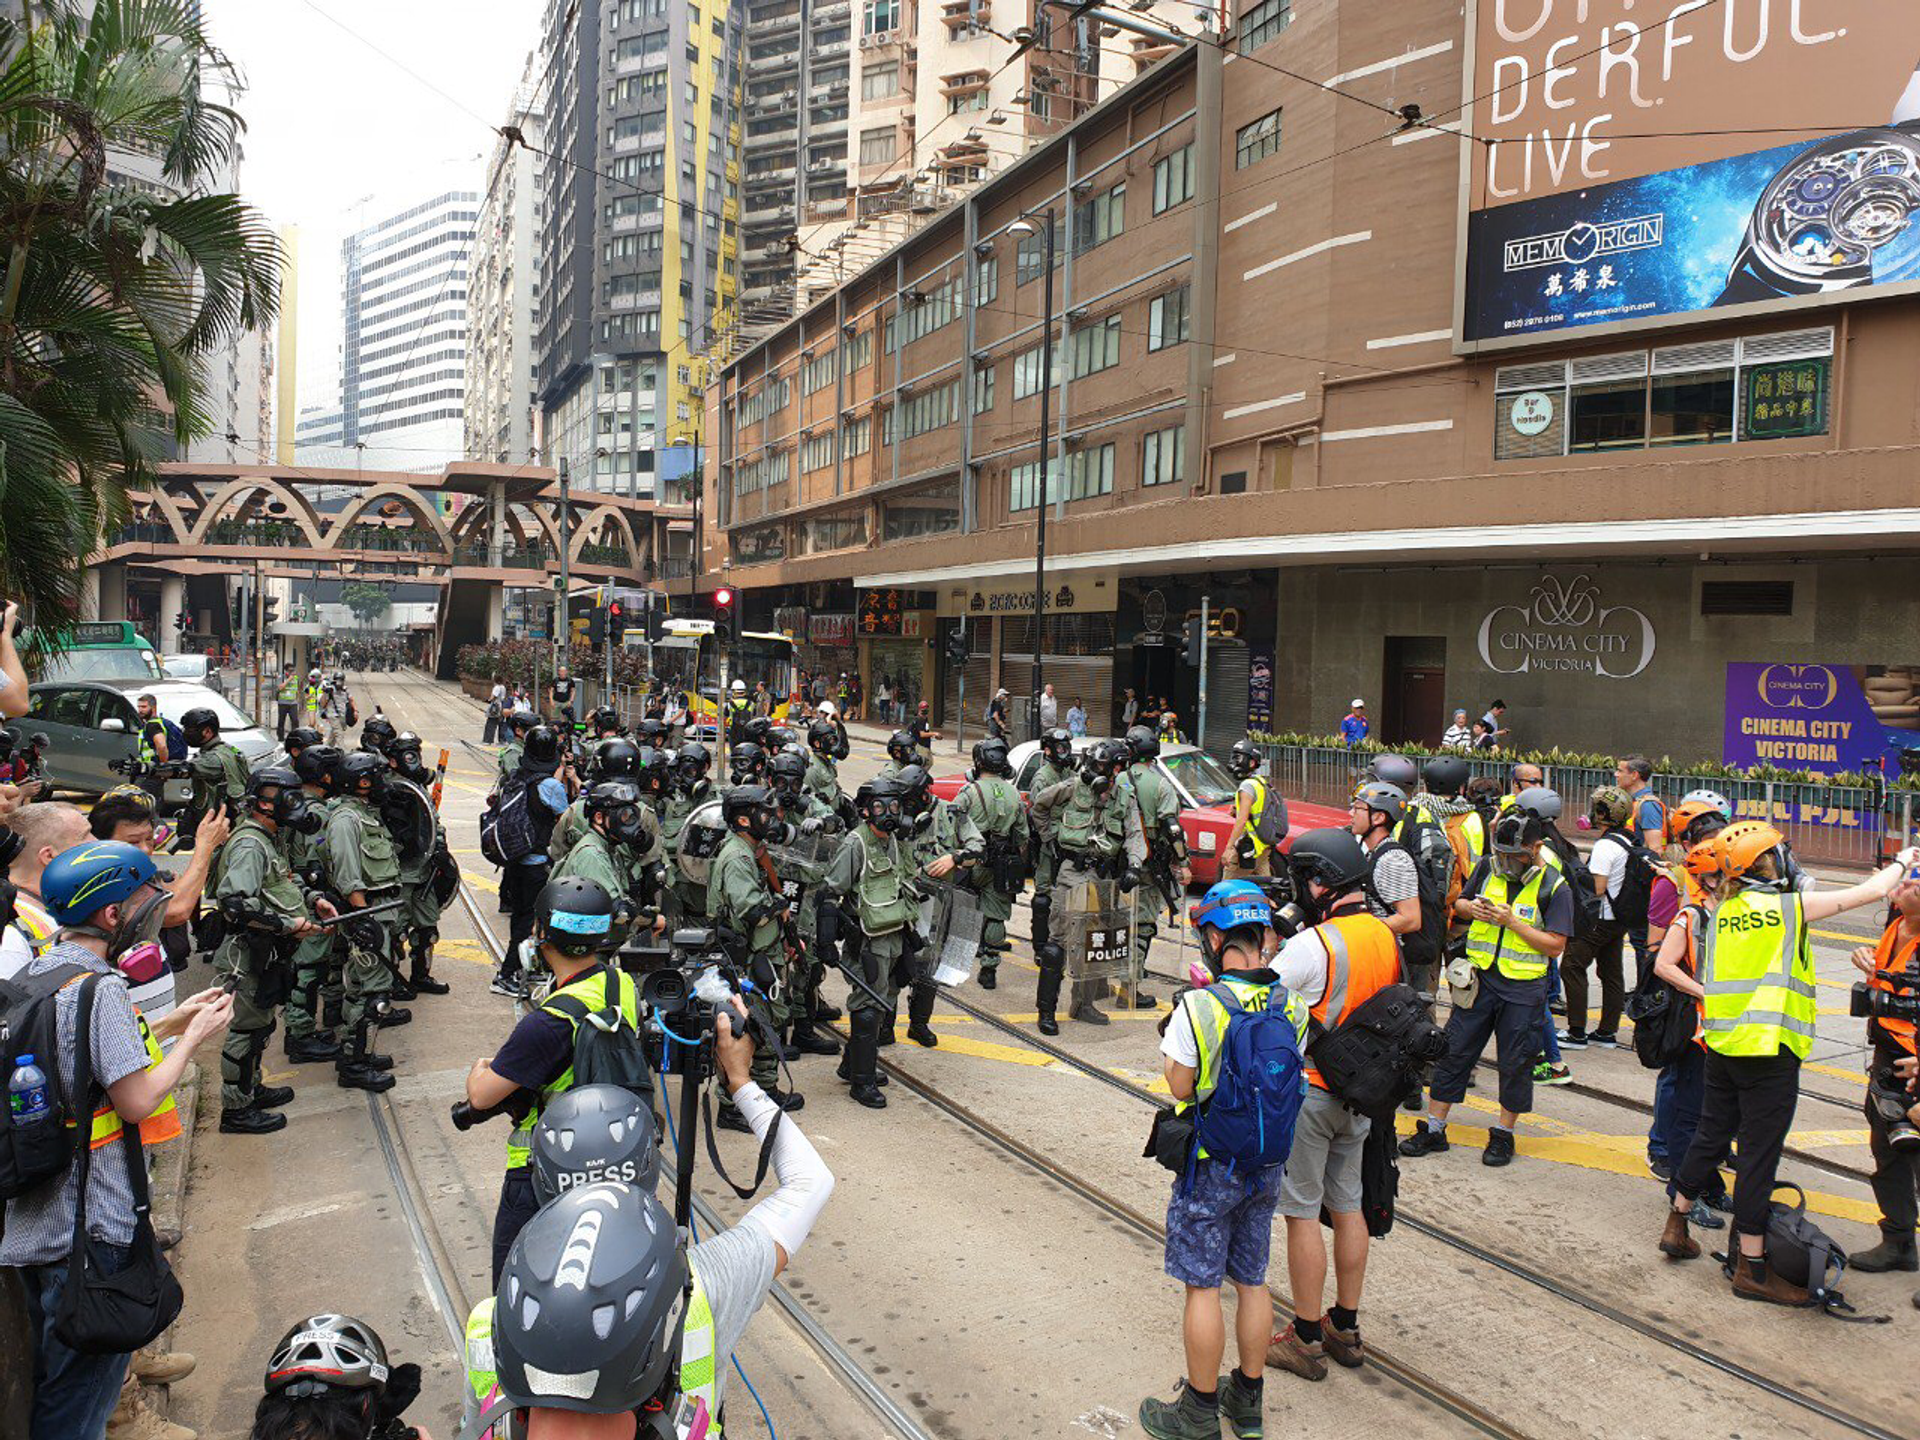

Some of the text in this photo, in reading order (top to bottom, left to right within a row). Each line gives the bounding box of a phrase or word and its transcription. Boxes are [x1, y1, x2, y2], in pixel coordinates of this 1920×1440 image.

[1488, 114, 1612, 198] LIVE
[1544, 264, 1618, 297] 萬希泉
[1500, 633, 1631, 652] CINEMA CITY
[1532, 658, 1593, 671] VICTORIA
[1768, 680, 1826, 690] CINEMA CITY
[1741, 717, 1852, 739] CINEMA CITY
[1755, 740, 1838, 762] VICTORIA
[558, 916, 609, 930] PRESS
[1718, 910, 1781, 933] PRESS
[1087, 946, 1128, 961] POLICE
[557, 1160, 636, 1192] PRESS
[295, 1331, 335, 1342] PRESS
